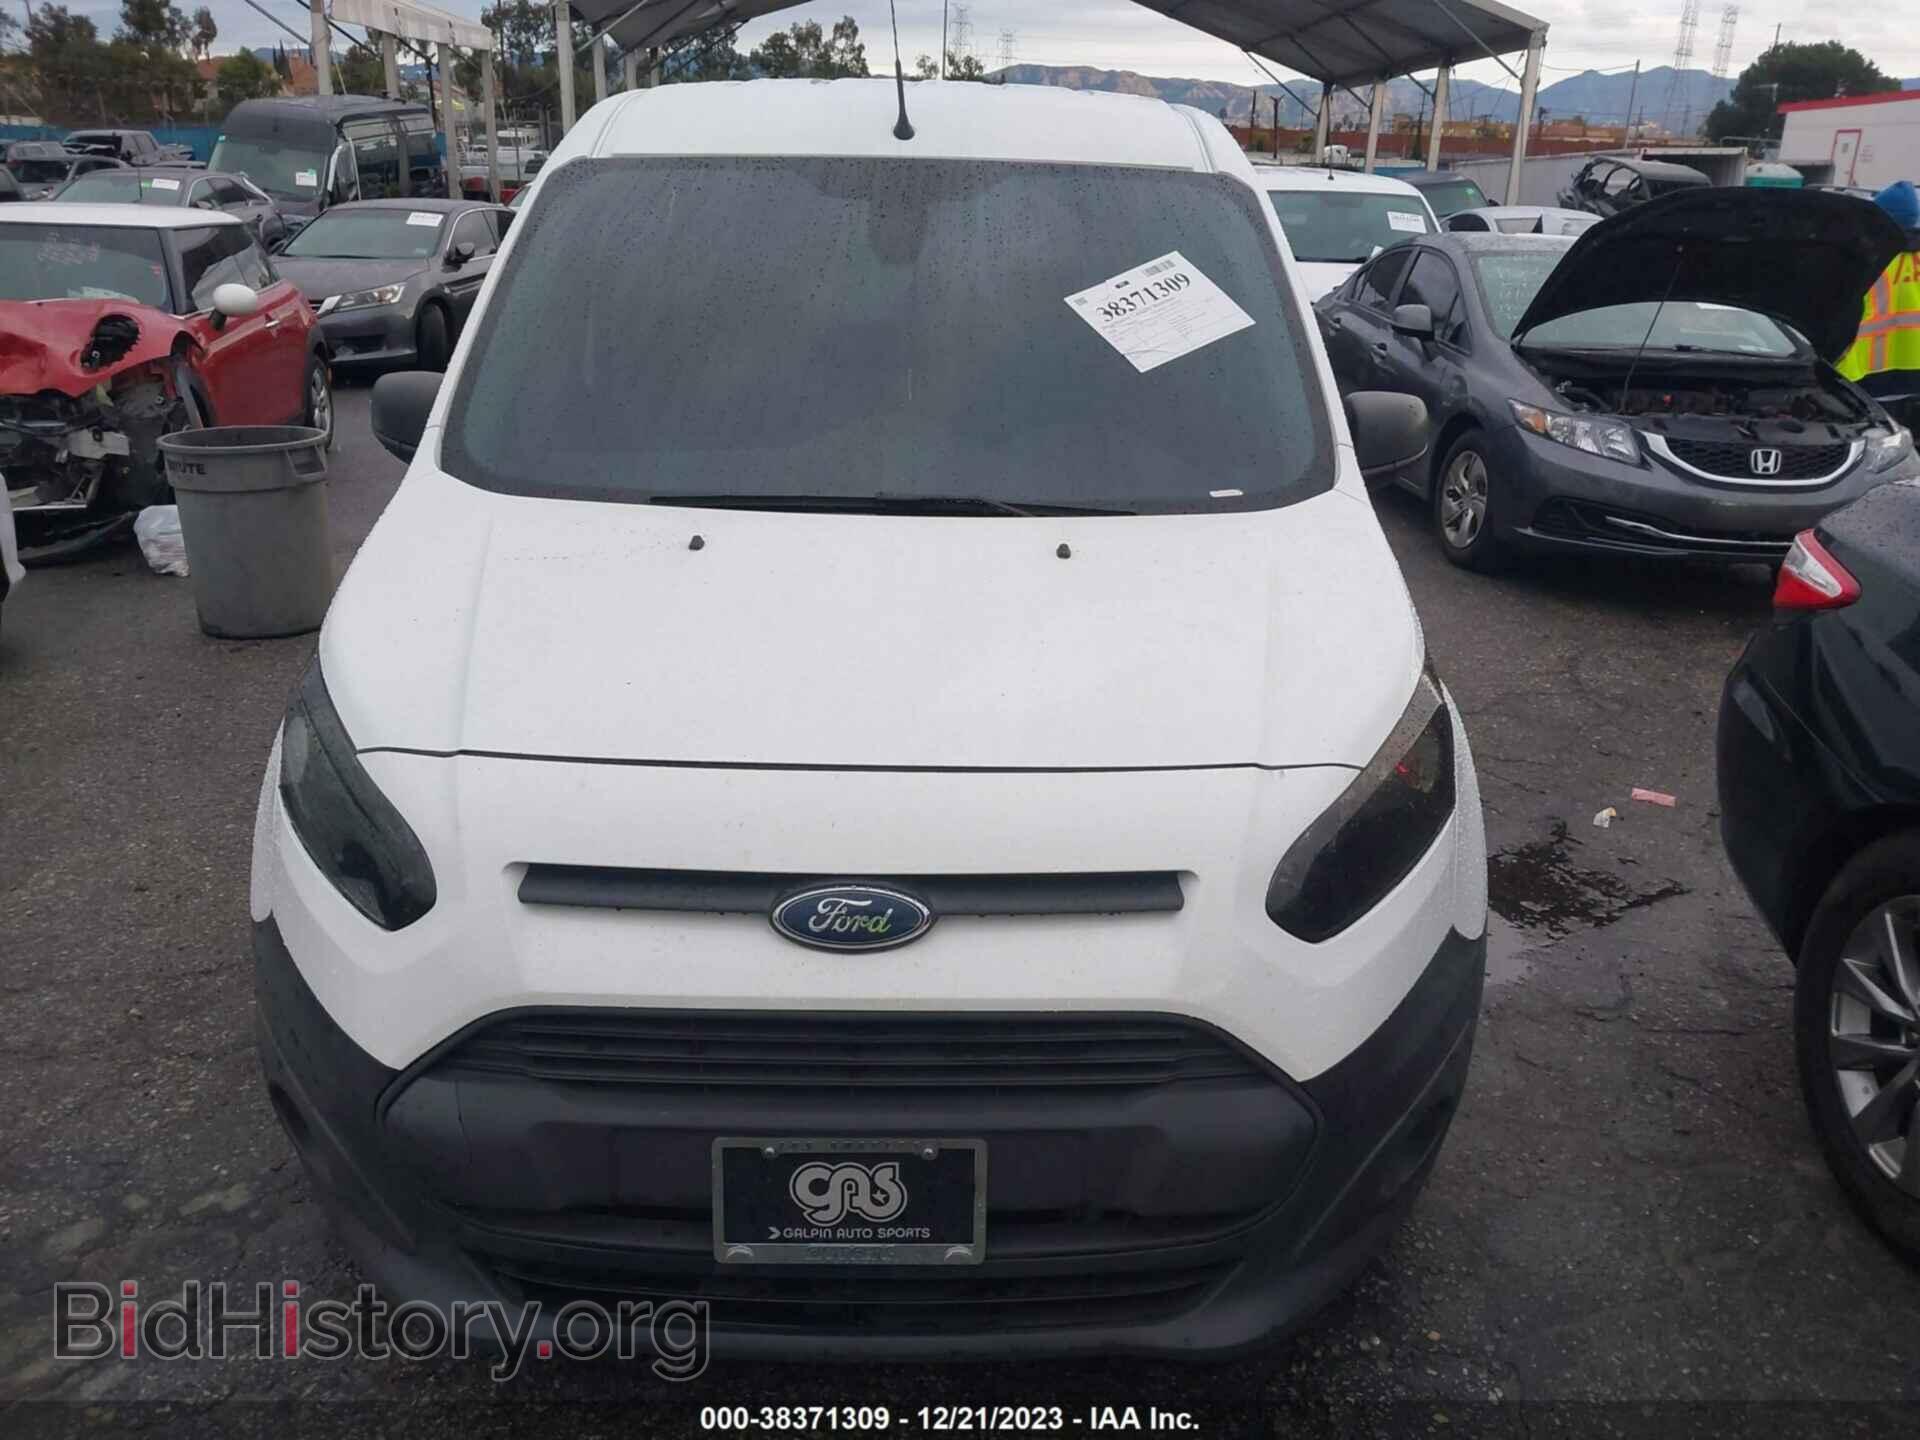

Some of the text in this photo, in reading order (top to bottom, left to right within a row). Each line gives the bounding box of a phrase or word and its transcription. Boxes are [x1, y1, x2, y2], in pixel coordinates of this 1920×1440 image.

[1096, 273, 1191, 321] 38371309
[808, 897, 894, 933] Ford
[783, 1227, 930, 1239] GALPIN AUTO SPORTS
